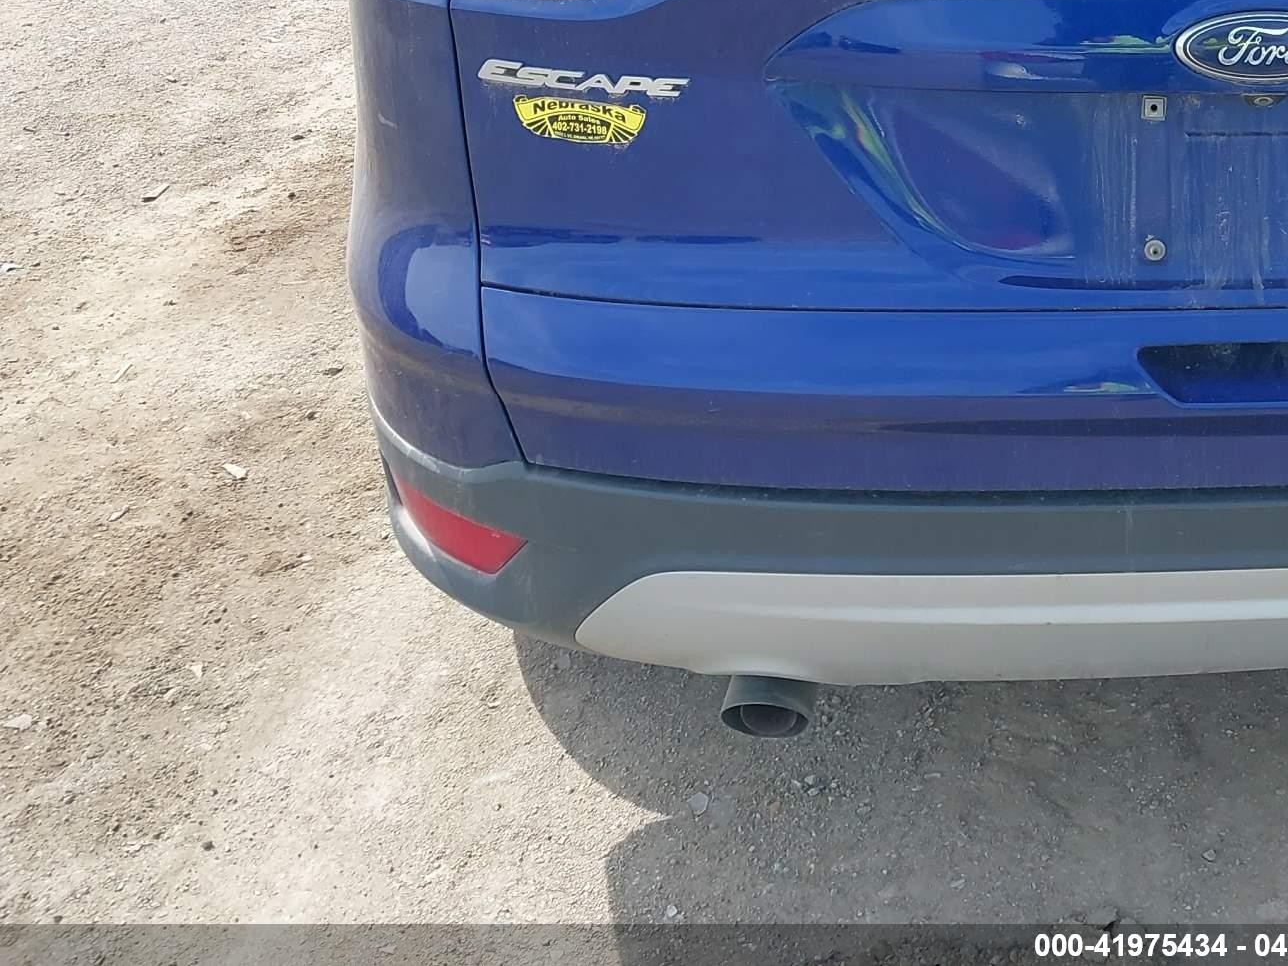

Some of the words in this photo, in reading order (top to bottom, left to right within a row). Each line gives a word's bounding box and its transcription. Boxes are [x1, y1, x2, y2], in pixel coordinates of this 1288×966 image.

[477, 58, 690, 97] ESCAPE
[532, 98, 626, 124] Nebraska
[557, 114, 576, 122] Auto
[578, 115, 601, 125] Sales
